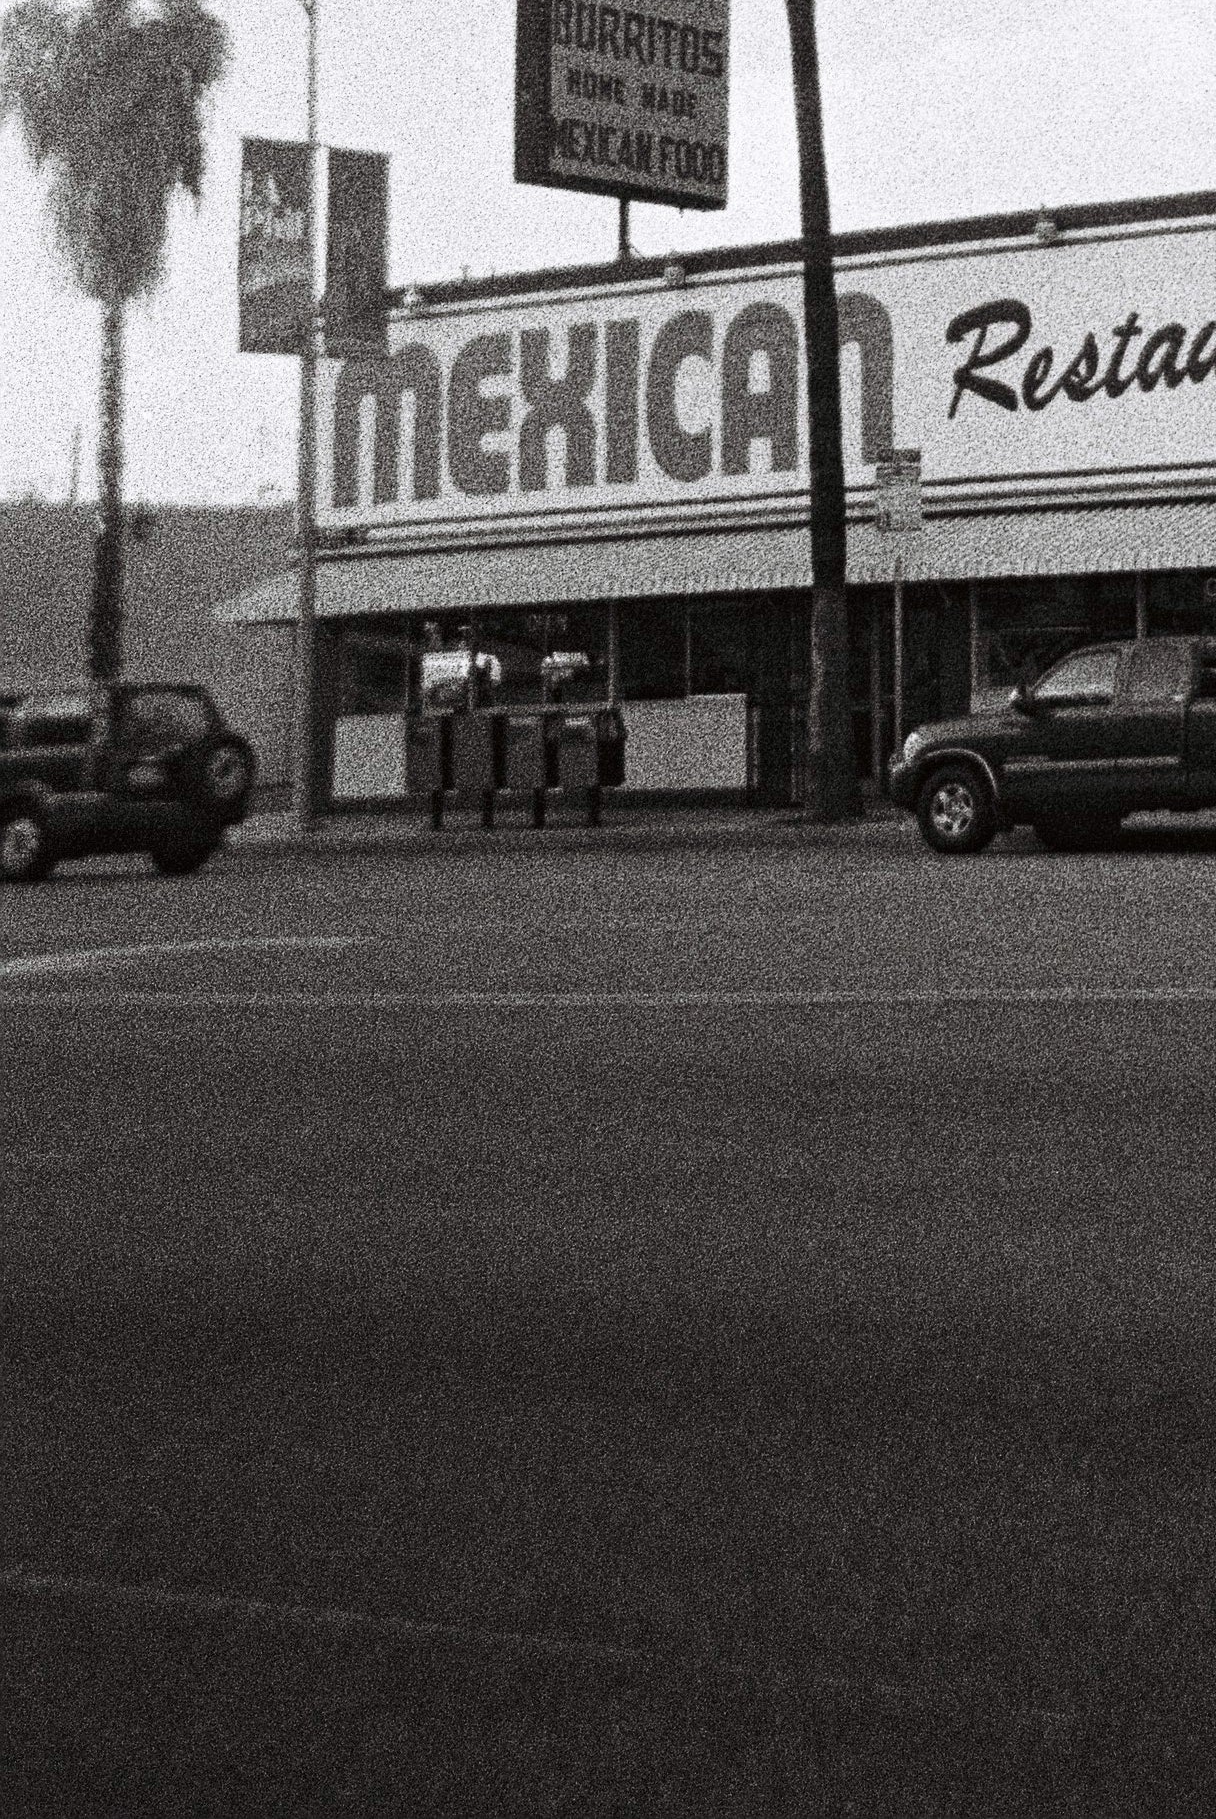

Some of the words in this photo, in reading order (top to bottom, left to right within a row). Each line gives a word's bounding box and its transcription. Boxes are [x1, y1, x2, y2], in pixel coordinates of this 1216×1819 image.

[566, 68, 625, 106] HOME
[641, 83, 698, 120] MADE
[550, 116, 653, 174] MEXICAN
[659, 135, 725, 185] FOOD
